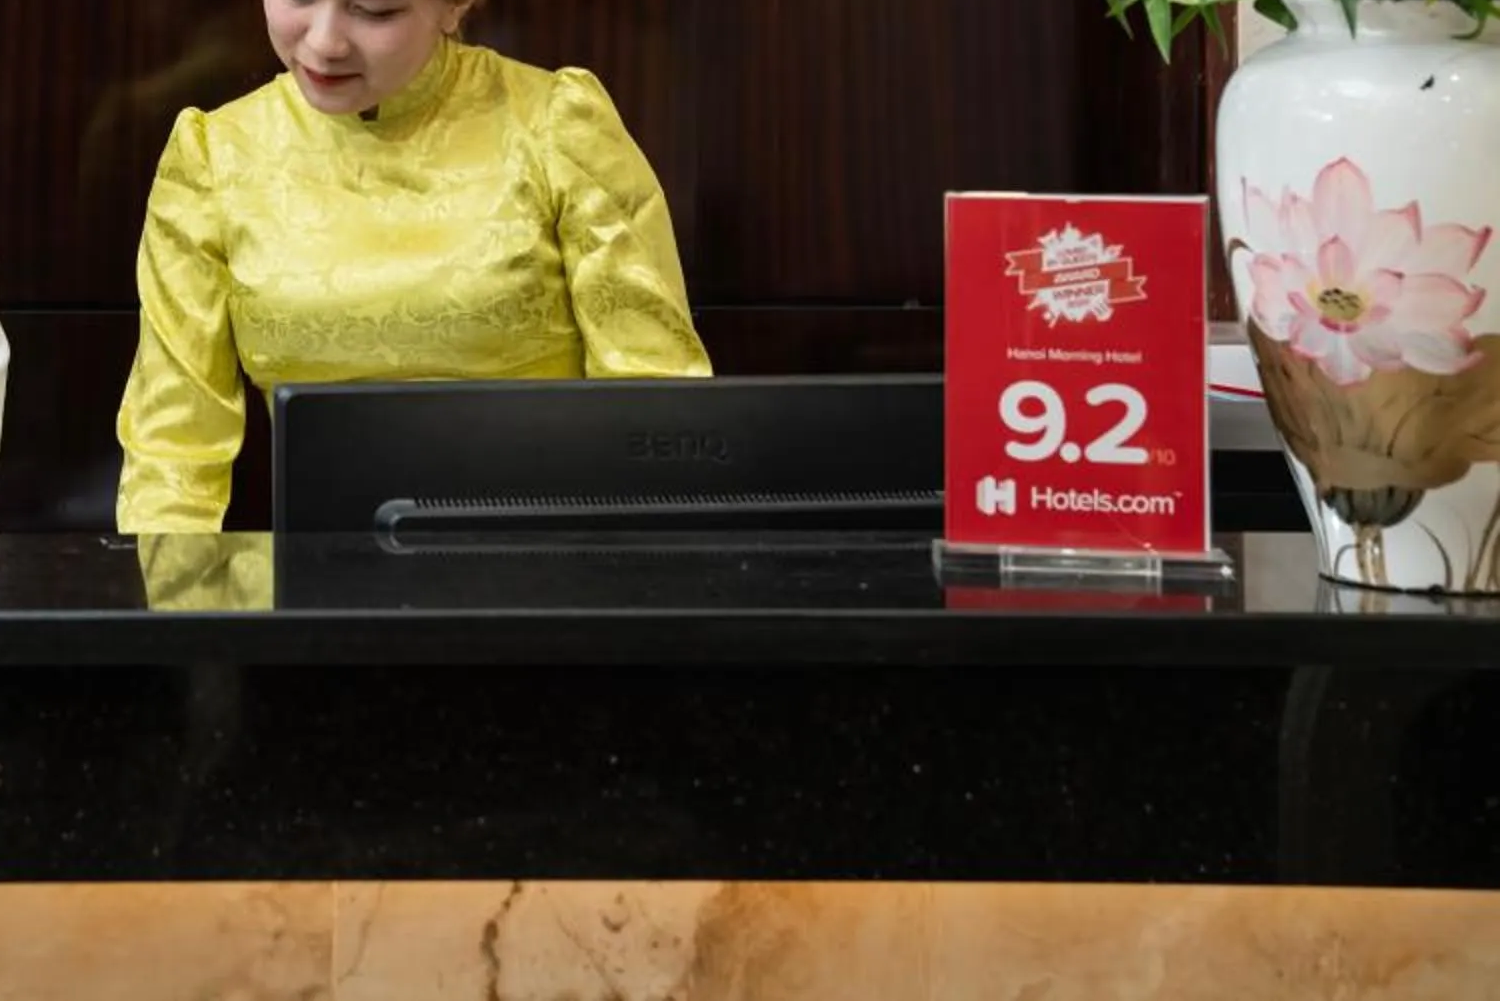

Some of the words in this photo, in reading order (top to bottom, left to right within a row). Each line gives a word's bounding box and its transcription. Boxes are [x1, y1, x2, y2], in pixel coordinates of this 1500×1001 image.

[1006, 346, 1047, 361] Hanoi
[1048, 347, 1103, 366] Morning
[1105, 349, 1143, 364] Hotel
[999, 379, 1150, 465] 9.2
[1030, 485, 1176, 516] Hotels.com
